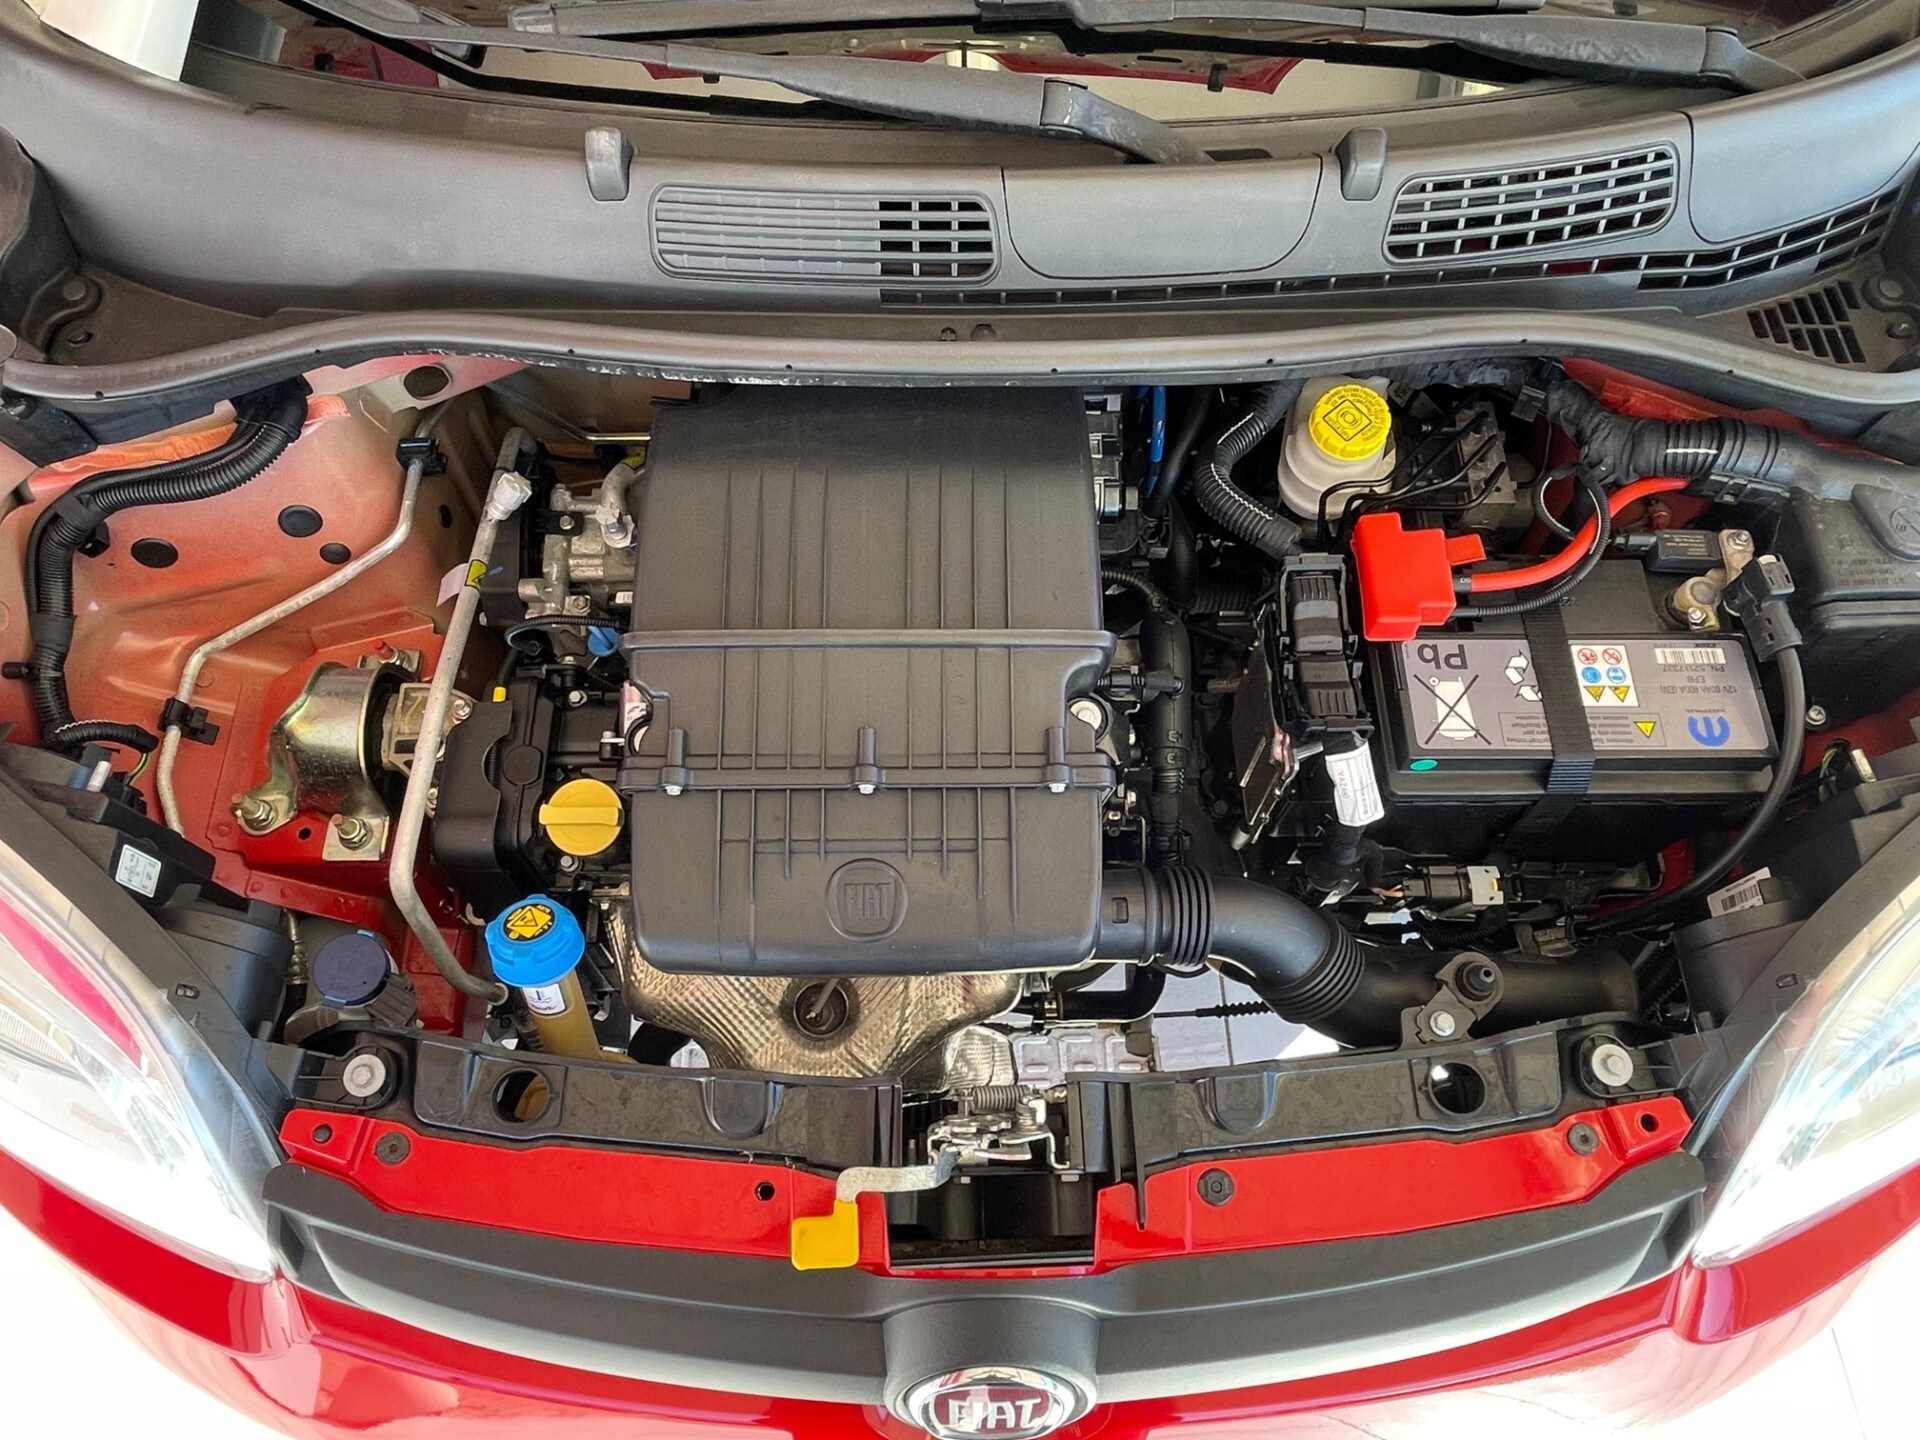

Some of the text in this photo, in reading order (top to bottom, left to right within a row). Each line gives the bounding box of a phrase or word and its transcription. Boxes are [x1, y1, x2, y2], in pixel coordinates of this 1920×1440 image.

[1417, 643, 1469, 670] Pb
[843, 882, 891, 920] FIAT
[947, 1397, 1042, 1430] FIAT
